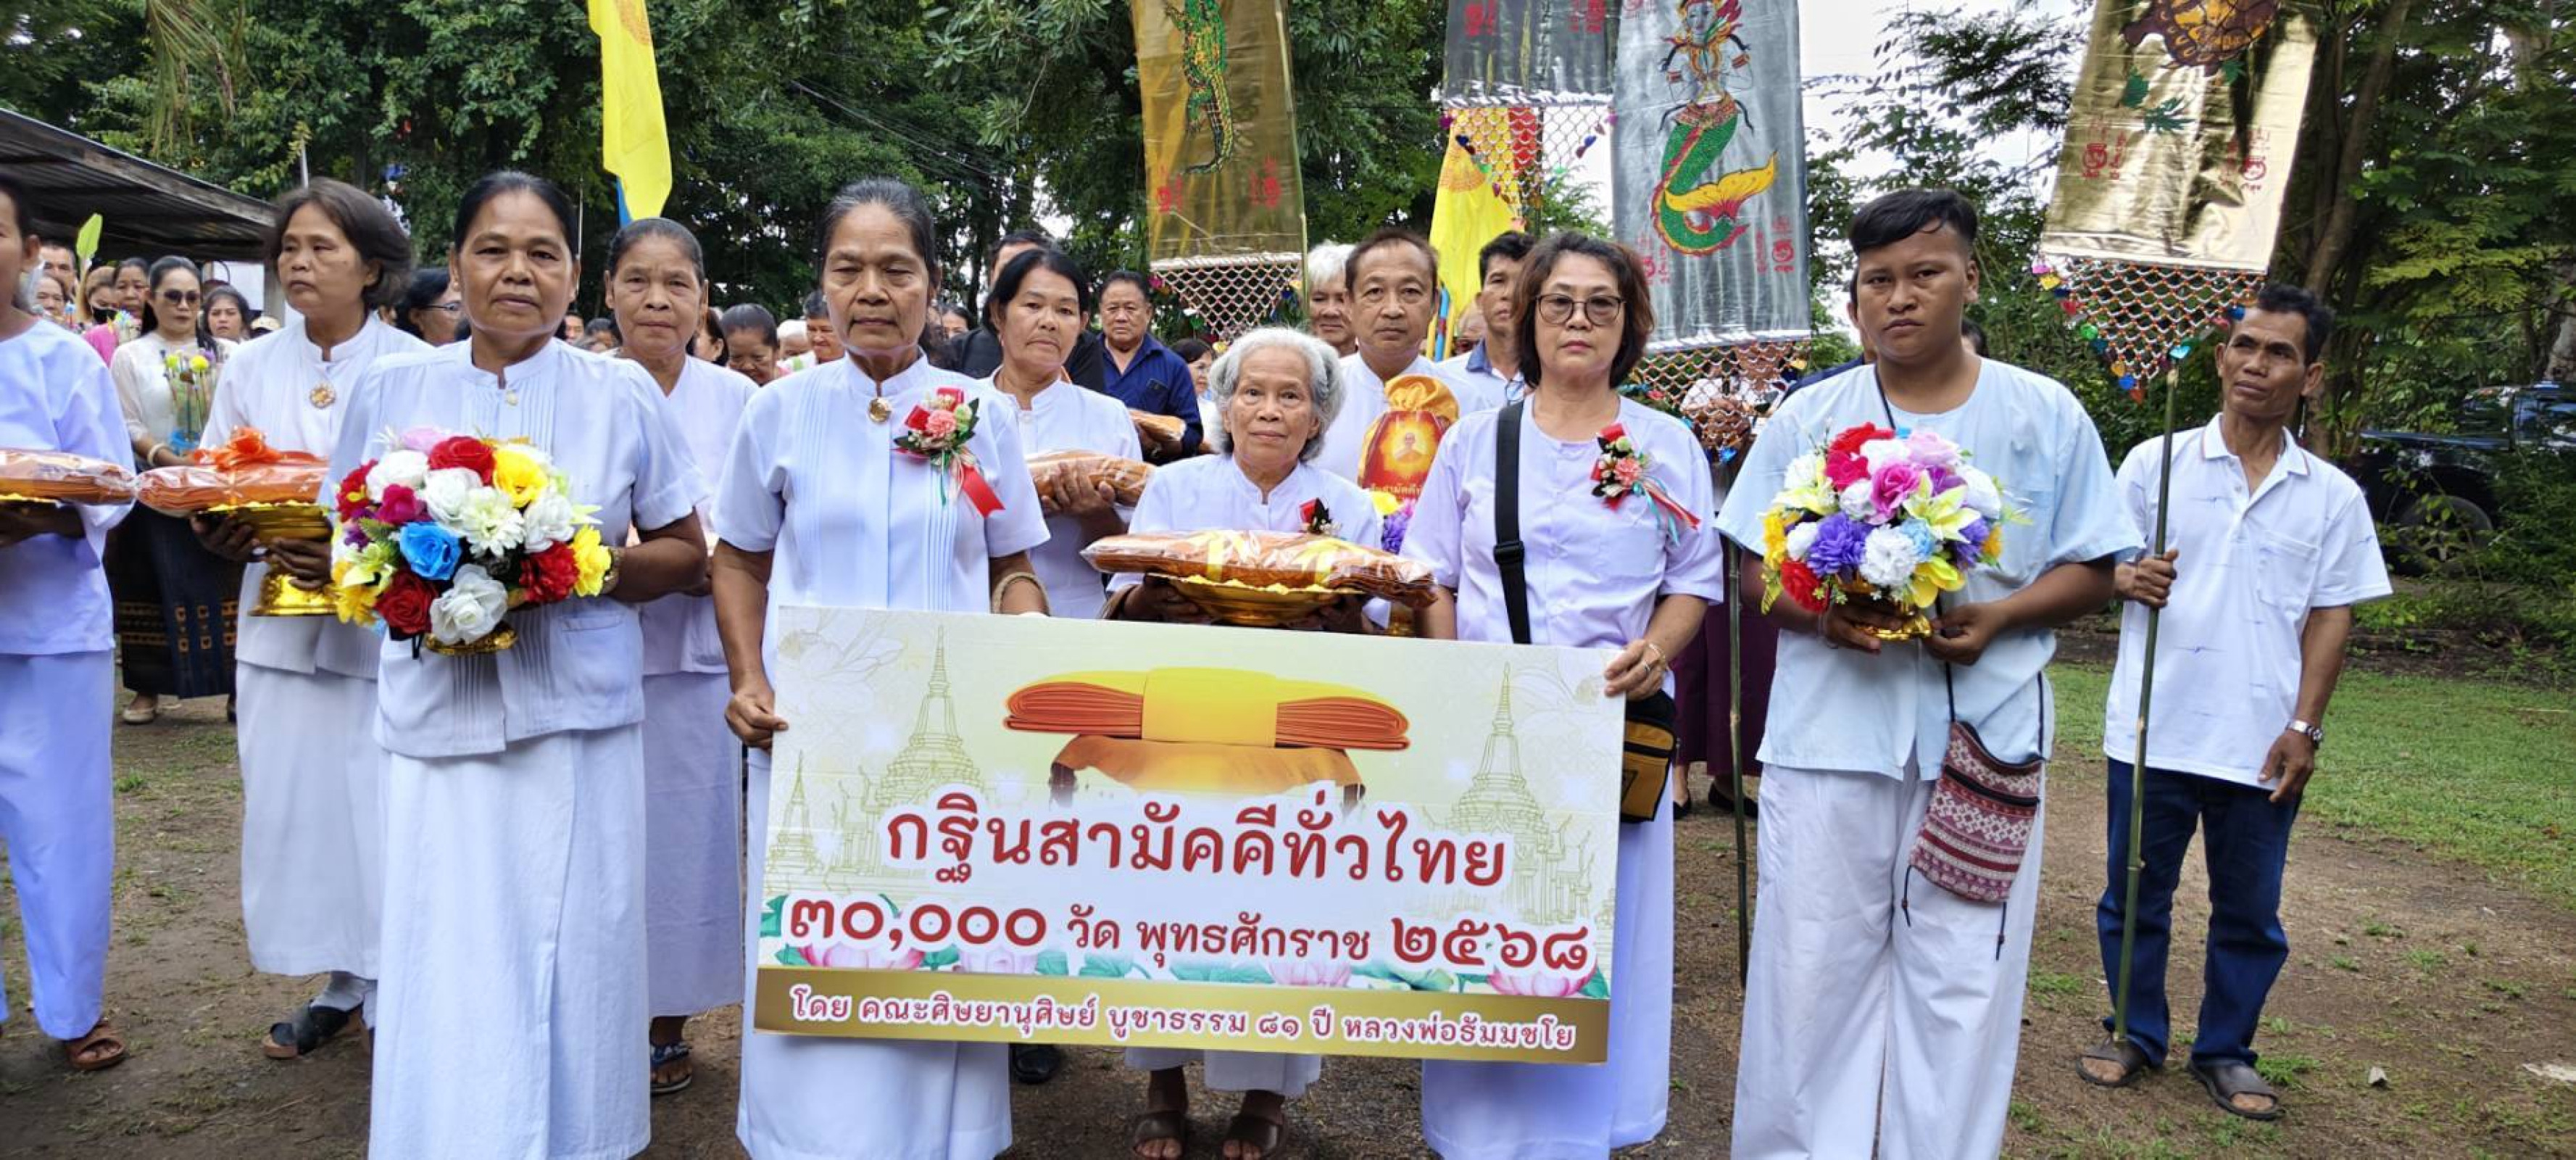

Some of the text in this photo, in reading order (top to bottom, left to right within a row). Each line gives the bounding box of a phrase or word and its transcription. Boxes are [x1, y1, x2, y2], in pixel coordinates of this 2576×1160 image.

[887, 790, 1504, 886] กฐินสามัคคีทั่วไทย
[792, 898, 1587, 970] ๓๐,๐๐๐ วัด พุทธศักราช ๒๕๖๘
[794, 989, 1574, 1046] โดย คณะศิษยานุศิษย์ บูชาธรรม ๘๑ ปี หลวงพ่อธัมมชโย
